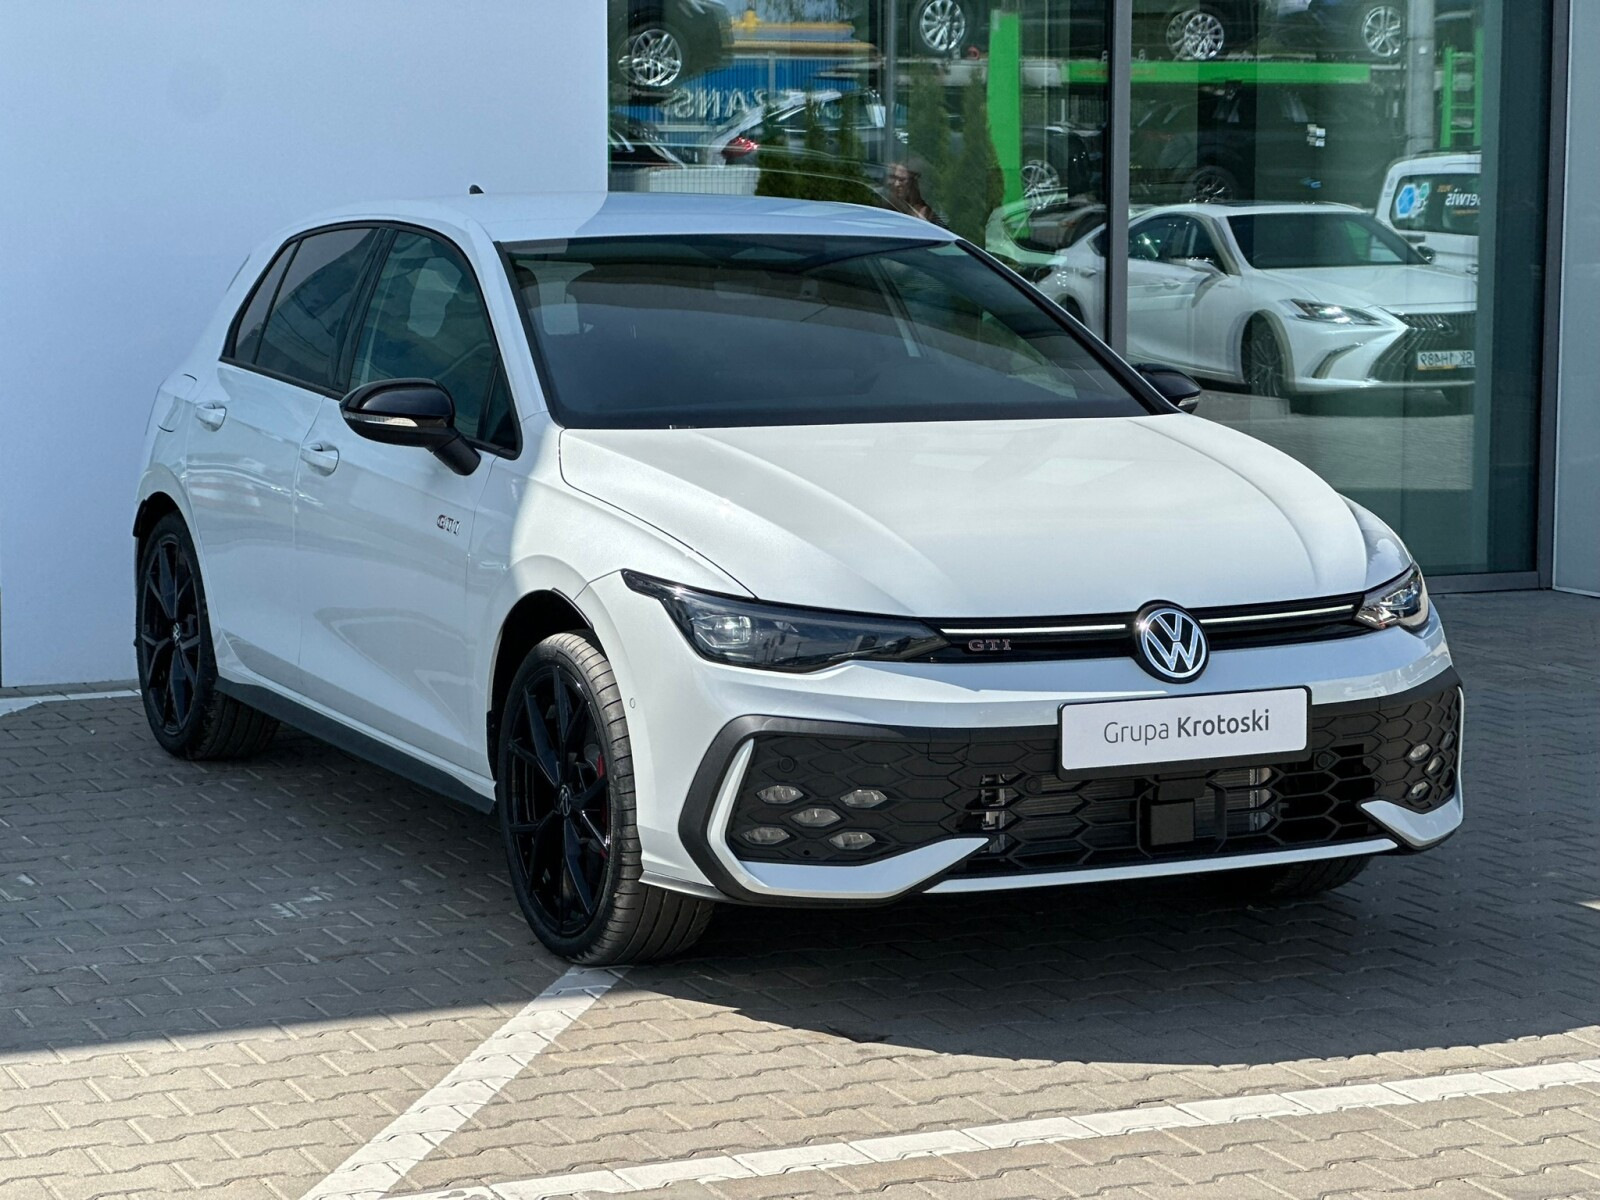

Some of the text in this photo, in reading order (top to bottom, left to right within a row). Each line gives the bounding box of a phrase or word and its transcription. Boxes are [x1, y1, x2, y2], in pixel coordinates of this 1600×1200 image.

[968, 638, 1012, 651] GTI
[1103, 708, 1270, 746] Grupa Krotoski
